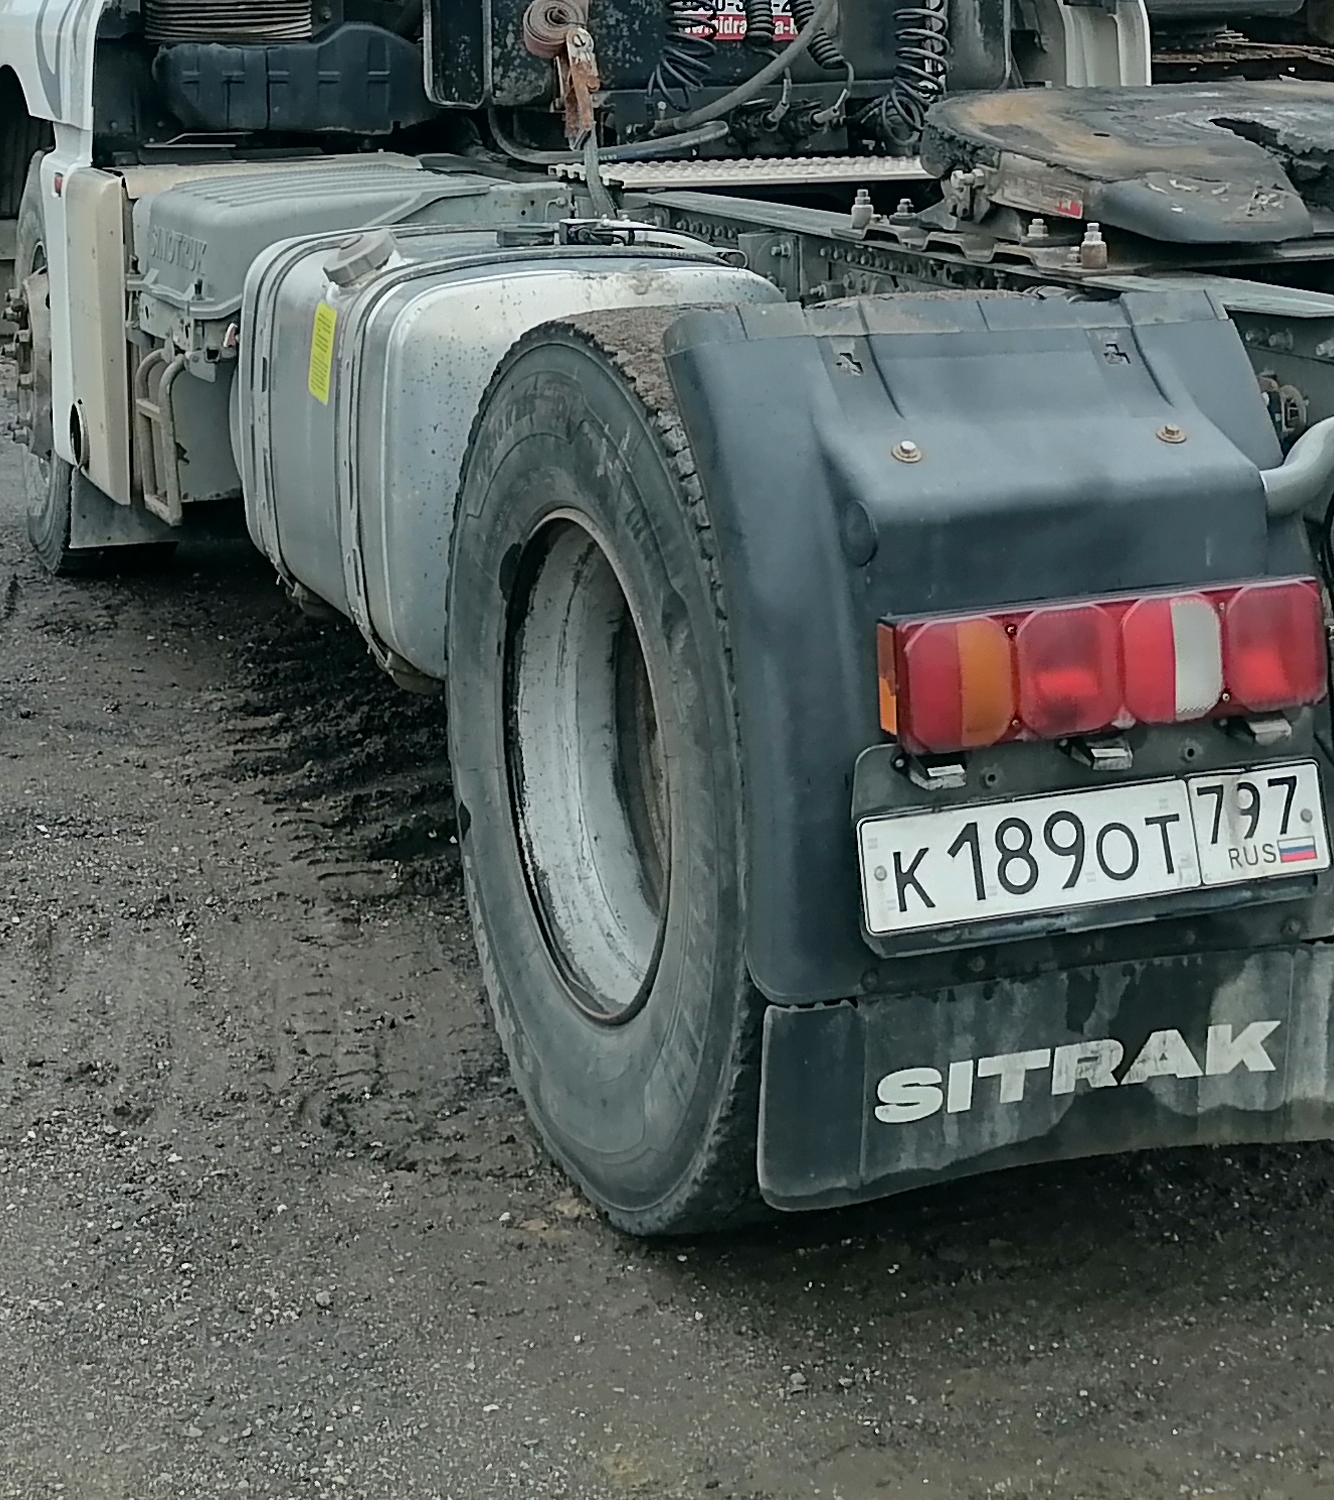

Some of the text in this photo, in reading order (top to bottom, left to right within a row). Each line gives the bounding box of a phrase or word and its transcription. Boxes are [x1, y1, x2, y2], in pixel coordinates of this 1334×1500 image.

[1196, 776, 1298, 845] 797
[1229, 844, 1278, 870] RUS
[874, 1020, 1282, 1124] SITRAK
